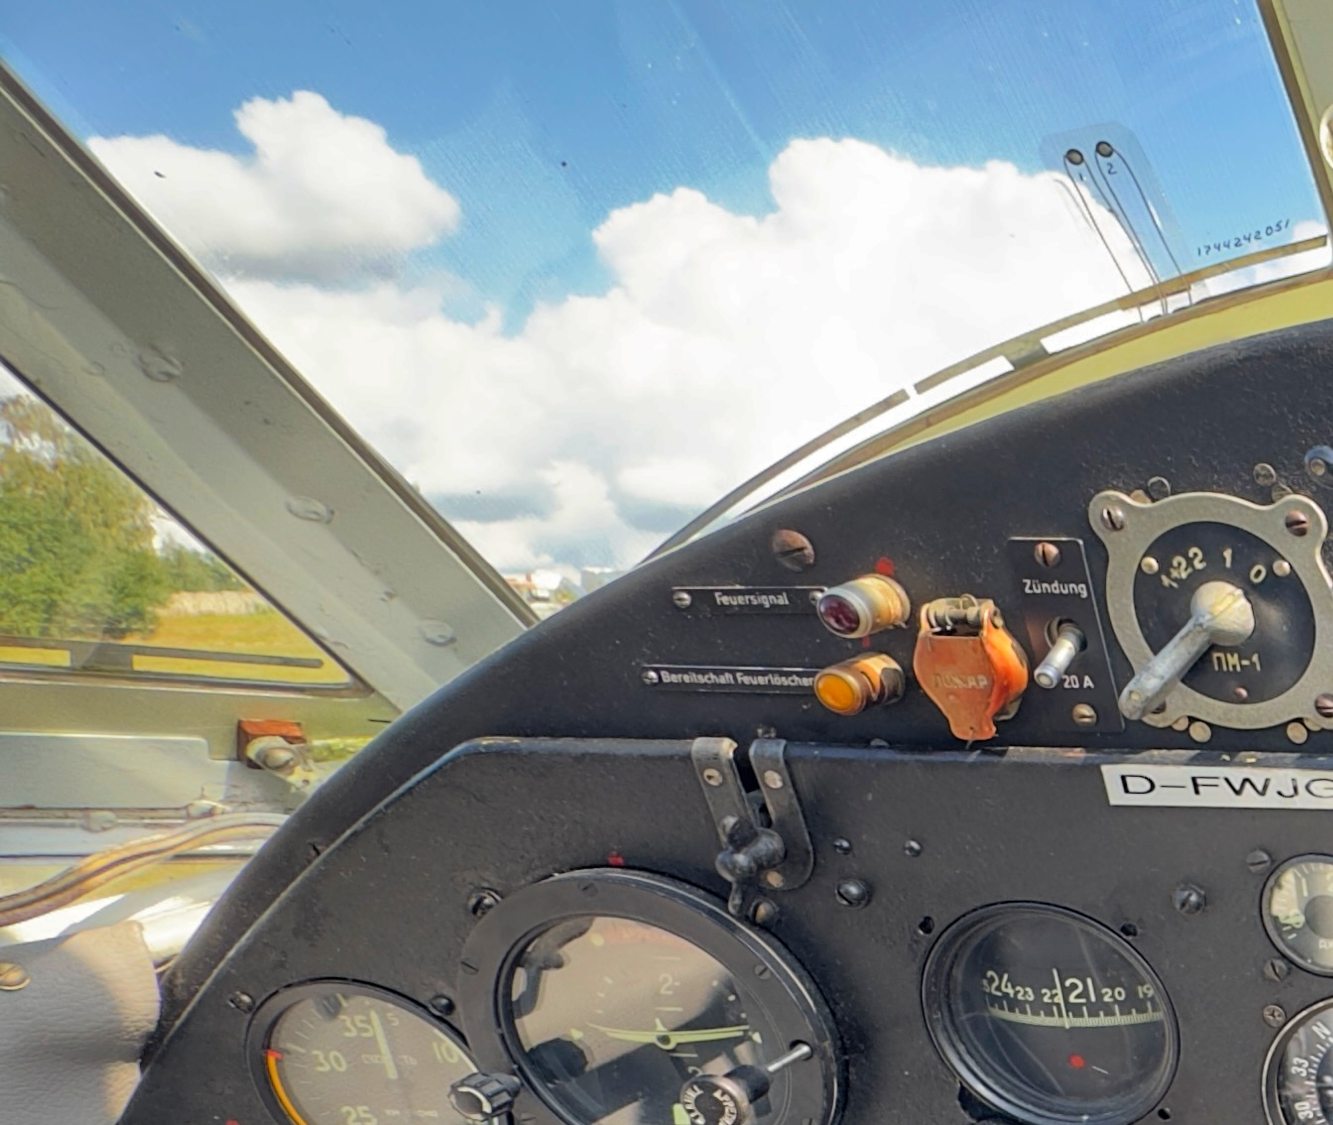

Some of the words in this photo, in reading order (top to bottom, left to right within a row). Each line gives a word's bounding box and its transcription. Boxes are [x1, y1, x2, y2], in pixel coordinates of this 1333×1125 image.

[1023, 578, 1088, 598] Zündung
[714, 590, 789, 607] Feuersignal
[1212, 652, 1261, 673] ПМ-1
[661, 670, 734, 686] Bereitschaft
[736, 672, 814, 688] Feuerlöscher
